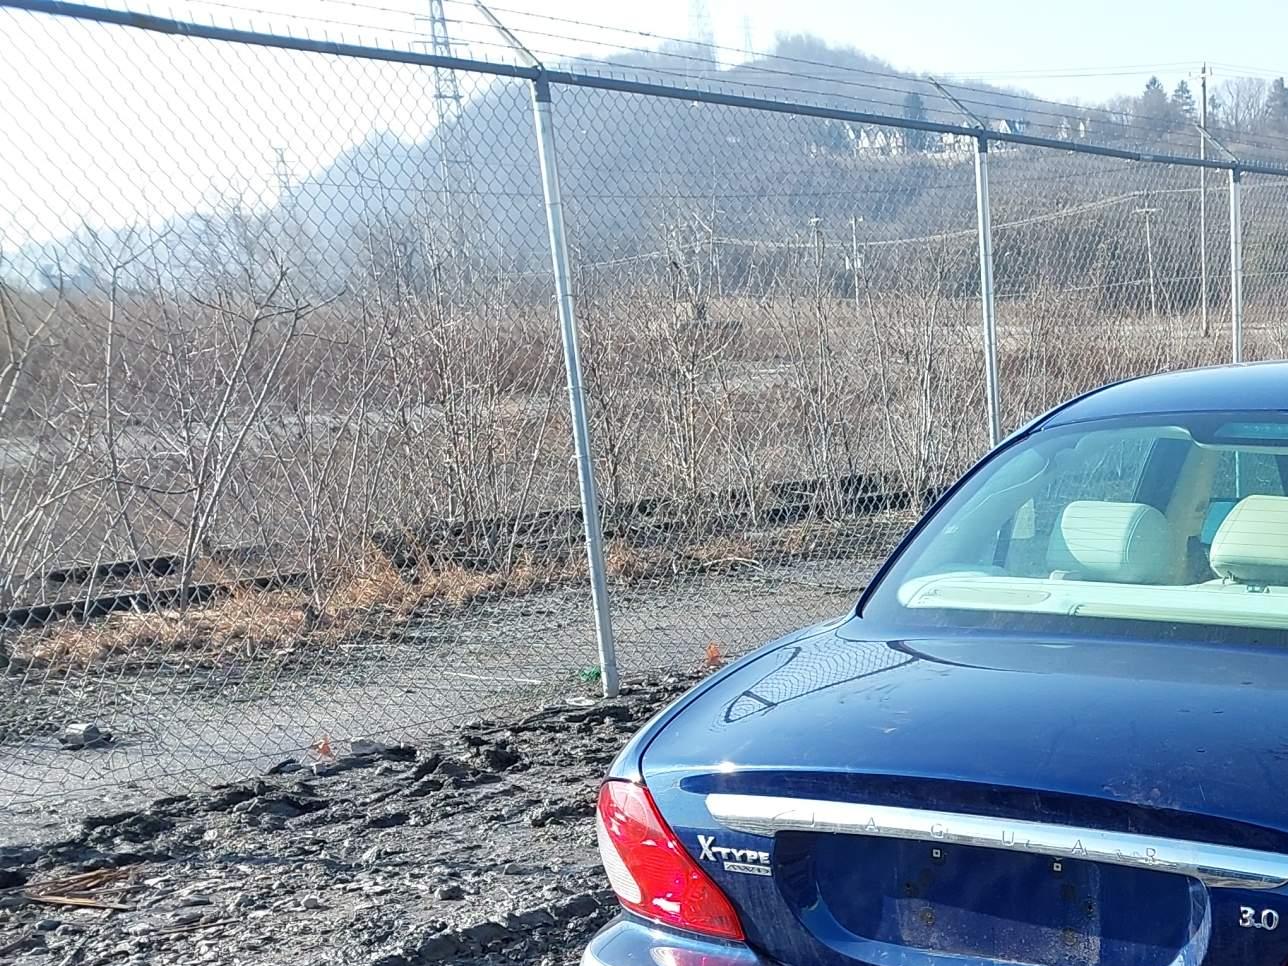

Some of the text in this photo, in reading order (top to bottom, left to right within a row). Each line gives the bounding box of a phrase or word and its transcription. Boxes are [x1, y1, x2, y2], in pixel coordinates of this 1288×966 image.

[805, 809, 1158, 865] JAGUAR
[726, 862, 771, 875] AWD
[1239, 906, 1280, 930] 3.0
